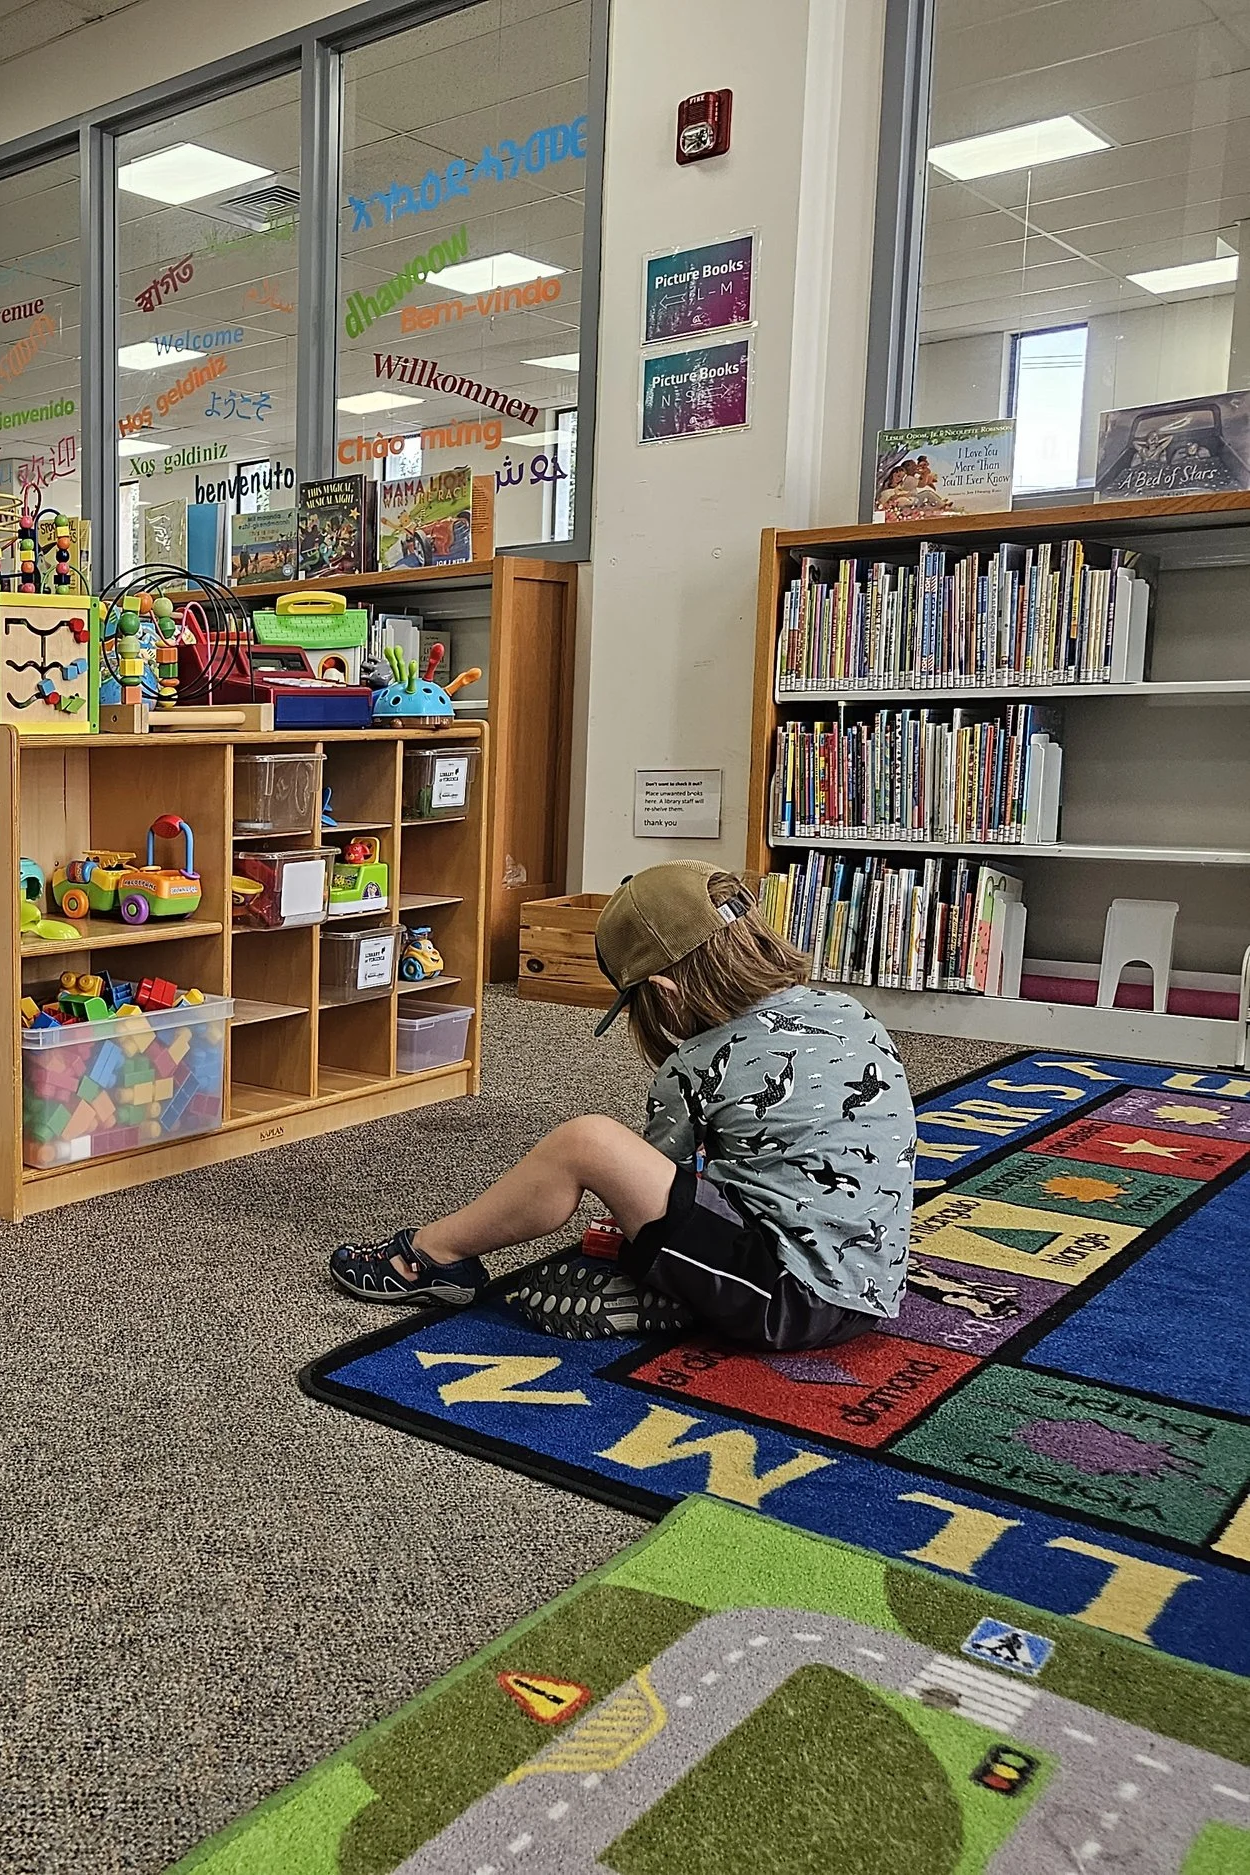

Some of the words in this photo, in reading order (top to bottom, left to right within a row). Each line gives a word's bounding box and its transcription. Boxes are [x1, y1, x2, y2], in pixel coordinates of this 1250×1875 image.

[345, 223, 470, 339] dhawoow
[655, 268, 700, 289] Picture
[702, 259, 744, 278] Books
[400, 275, 562, 334] Bem-vindo
[697, 287, 704, 300] L
[720, 281, 733, 296] M
[154, 327, 244, 356] Welcome
[156, 355, 228, 417] geldiniz
[373, 352, 540, 427] Willkommen
[652, 370, 698, 389] Picture
[699, 363, 740, 380] Books
[205, 389, 272, 421] ようこそ
[661, 394, 671, 407] N
[338, 432, 405, 465] Chào
[420, 418, 503, 451] mừng
[980, 425, 1013, 433] ROBINSON
[18, 436, 76, 494] 欢迎
[164, 442, 228, 473] gəldiniz
[965, 447, 982, 458] Love
[983, 444, 998, 457] You
[942, 475, 963, 487] You'll
[966, 475, 984, 486] Ever
[986, 472, 1010, 486] Know
[951, 461, 975, 475] More
[977, 458, 1000, 471] Than
[1119, 473, 1131, 489] A
[1134, 469, 1163, 488] Bed
[1164, 466, 1180, 488] of
[1180, 465, 1218, 482] Stars
[195, 461, 295, 504] benvenuto
[307, 487, 323, 499] THIS
[383, 479, 424, 499] MAMA
[430, 471, 468, 491] LION
[413, 493, 433, 506] THE
[438, 487, 468, 502] RACE
[306, 495, 334, 509] MUSICAL
[335, 493, 355, 505] NIGHT
[987, 1079, 1086, 1101] S
[937, 1319, 1001, 1348] dog
[413, 1348, 592, 1406] N
[841, 1359, 948, 1427] diamond
[1029, 1386, 1216, 1446] purple
